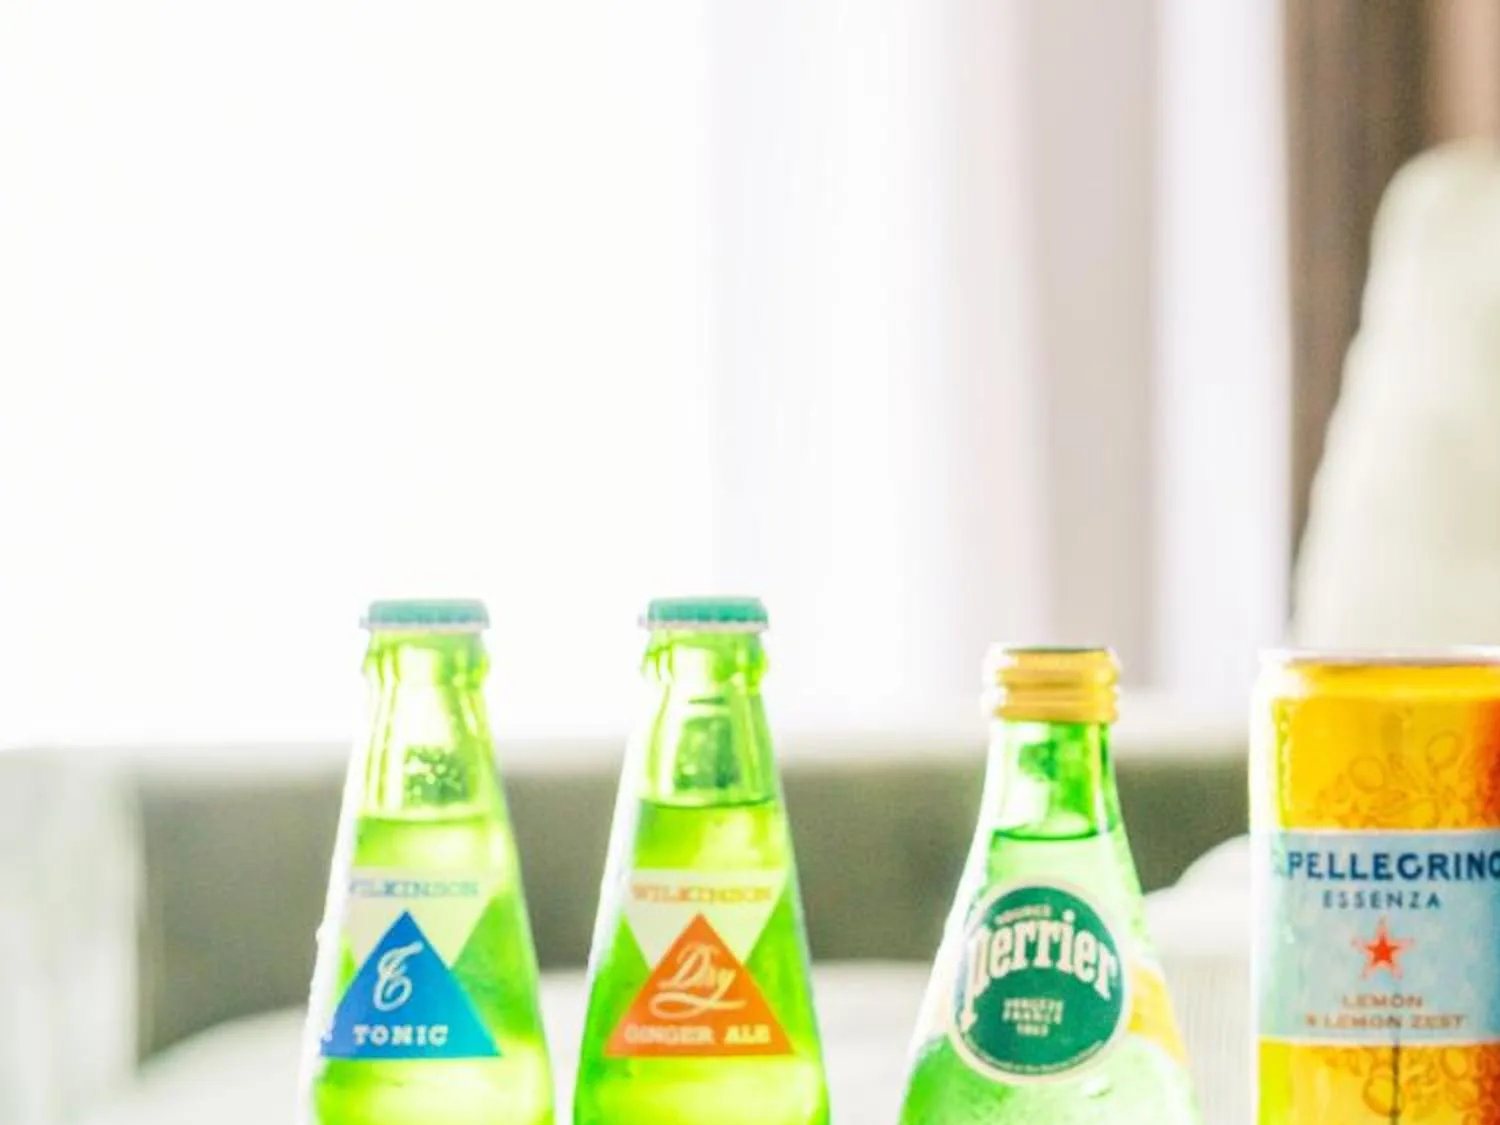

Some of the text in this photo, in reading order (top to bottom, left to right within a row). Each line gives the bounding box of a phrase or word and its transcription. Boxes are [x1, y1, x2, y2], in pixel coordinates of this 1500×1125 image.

[1322, 889, 1441, 910] ESSENZA
[1341, 993, 1423, 1009] LEMON
[1324, 1013, 1401, 1029] LEMON
[1411, 1013, 1466, 1029] ZEST
[353, 1023, 449, 1046] TONIC
[624, 1024, 772, 1046] GINGER ALE
